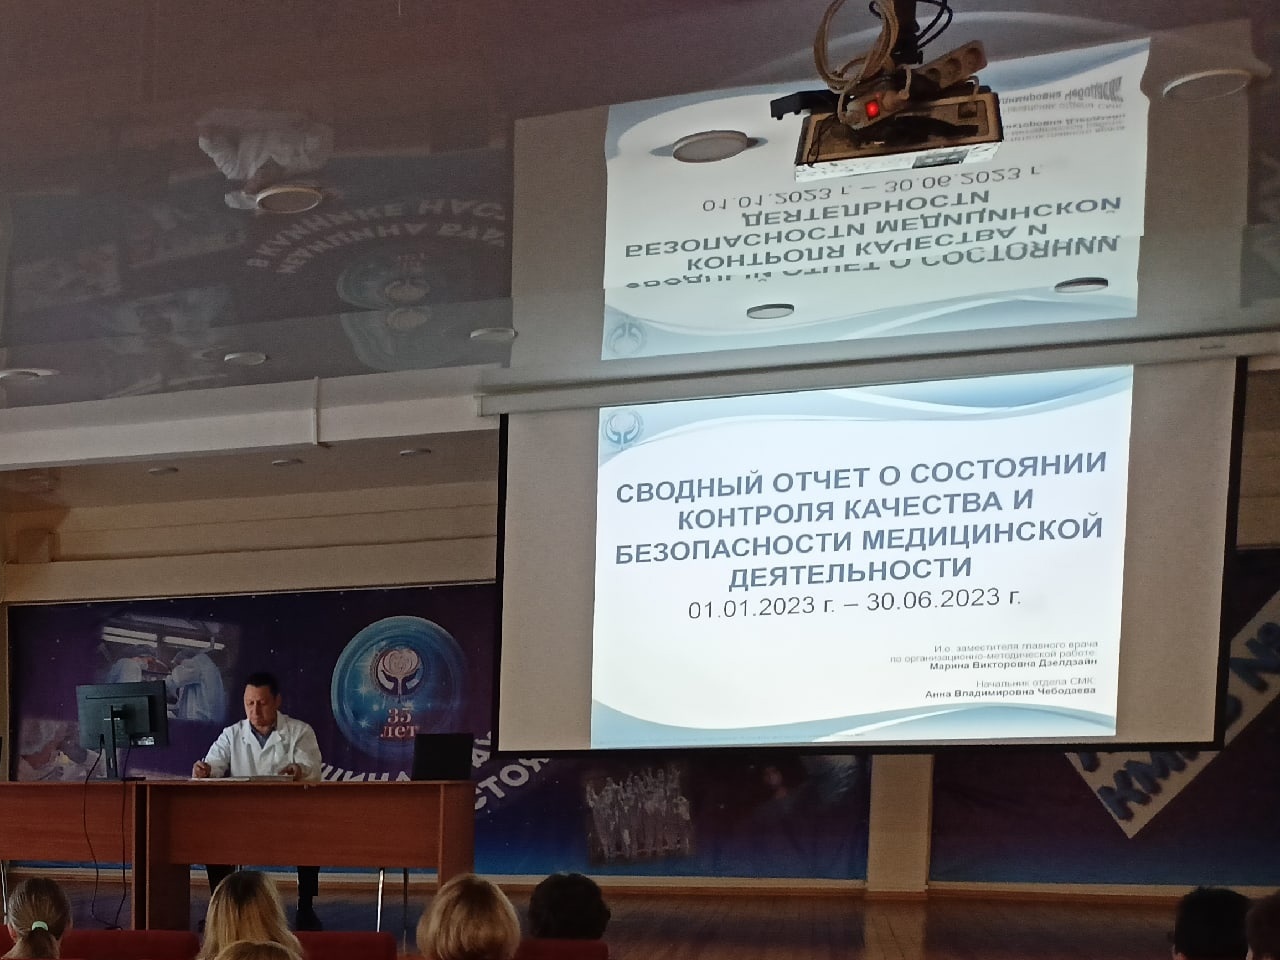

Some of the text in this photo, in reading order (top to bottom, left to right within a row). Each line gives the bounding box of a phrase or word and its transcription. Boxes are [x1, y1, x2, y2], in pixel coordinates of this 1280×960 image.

[617, 451, 1106, 504] СВОДНЫЙ ОТЧЕТ О СОСТОЯНИИ
[678, 488, 1033, 530] КОНТРОЛЯ КАЧЕСТВА И
[615, 512, 1103, 565] БЕЗОПАСНОСТИ МЕДИЦИНСКОЙ
[728, 557, 972, 592] ДЕЯТЕЛЬНОСТИ
[688, 596, 815, 619] 01.01.2023
[824, 600, 835, 613] г.
[867, 587, 1000, 611] 30.06.2023
[1010, 590, 1021, 605] г.
[929, 662, 970, 672] Марина
[972, 660, 1036, 671] Викторовна
[925, 690, 952, 699] Анна
[954, 687, 1035, 698] Владимировна
[387, 707, 412, 724] 35
